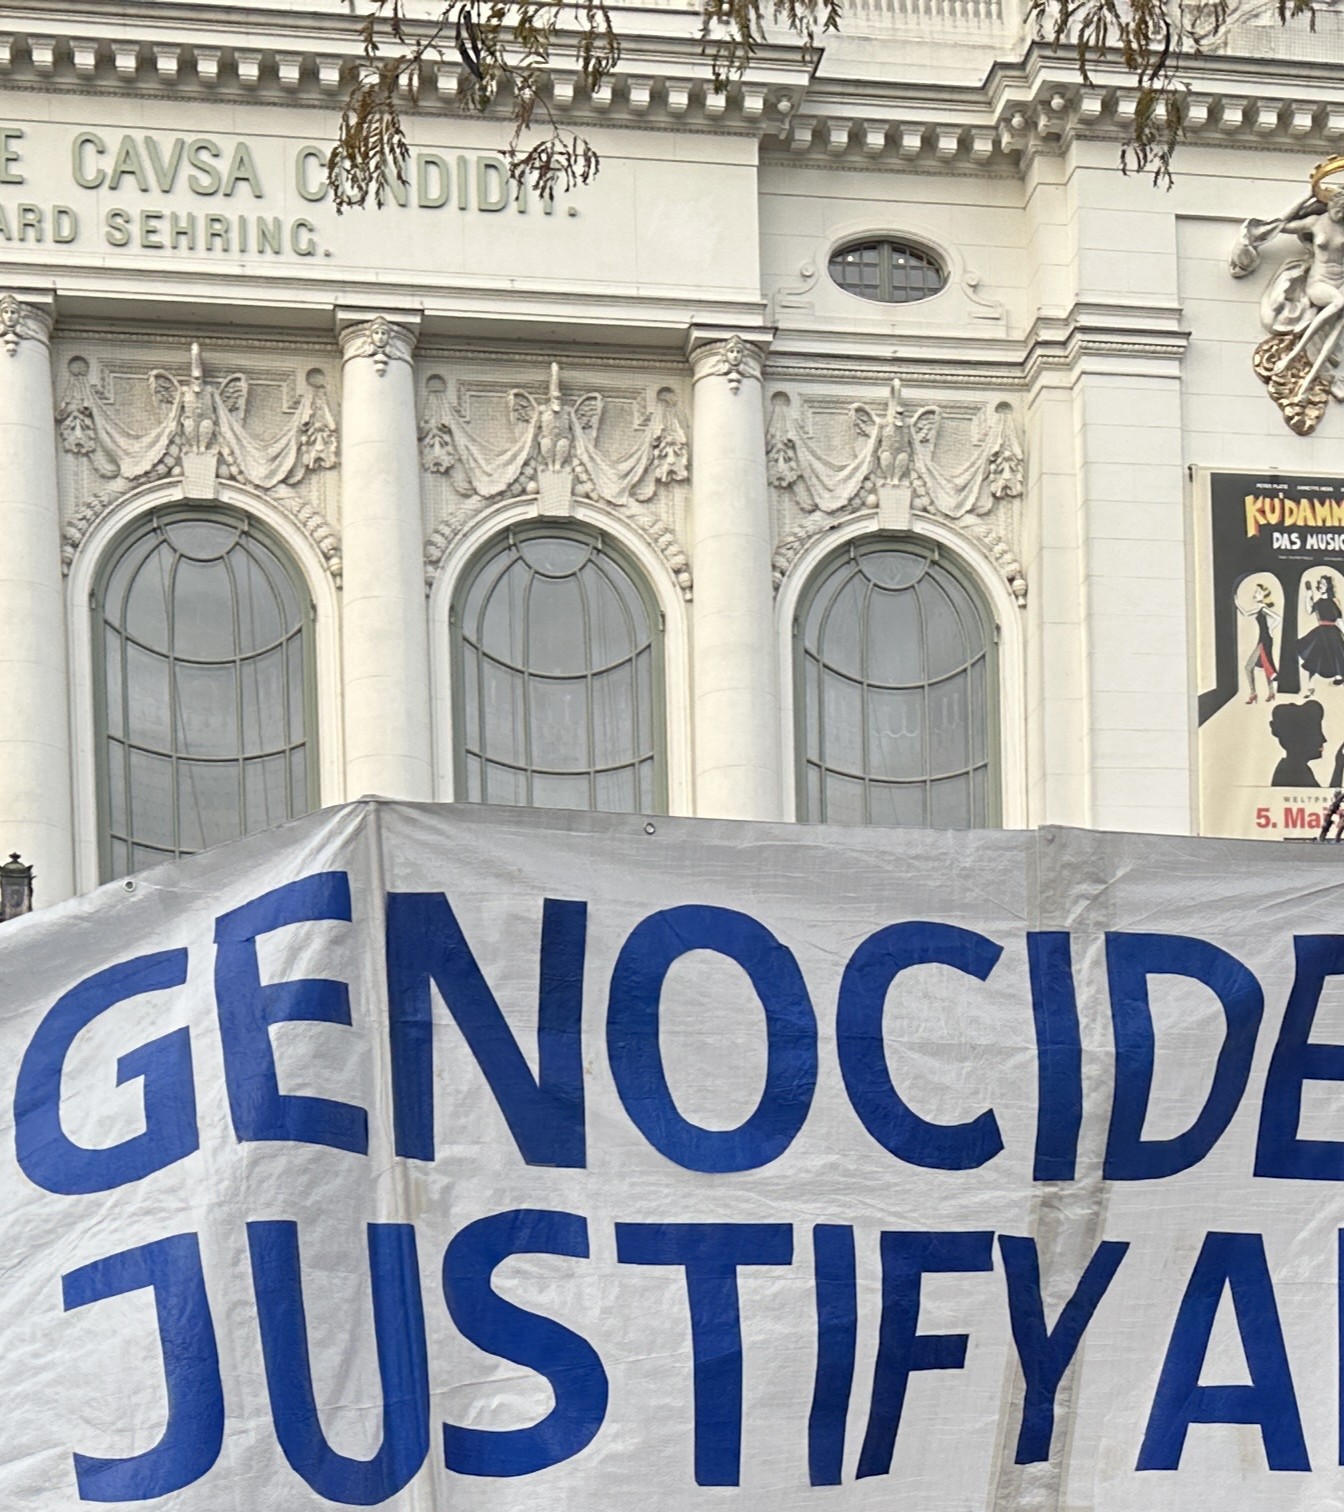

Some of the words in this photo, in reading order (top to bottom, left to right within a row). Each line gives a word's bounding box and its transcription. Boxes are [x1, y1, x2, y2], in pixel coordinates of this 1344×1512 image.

[72, 131, 263, 199] CAVSA
[104, 207, 332, 257] SEHRING.
[1272, 532, 1302, 550] DAS
[1256, 807, 1277, 829] 5.
[61, 1208, 1131, 1507] JUSTIFY
